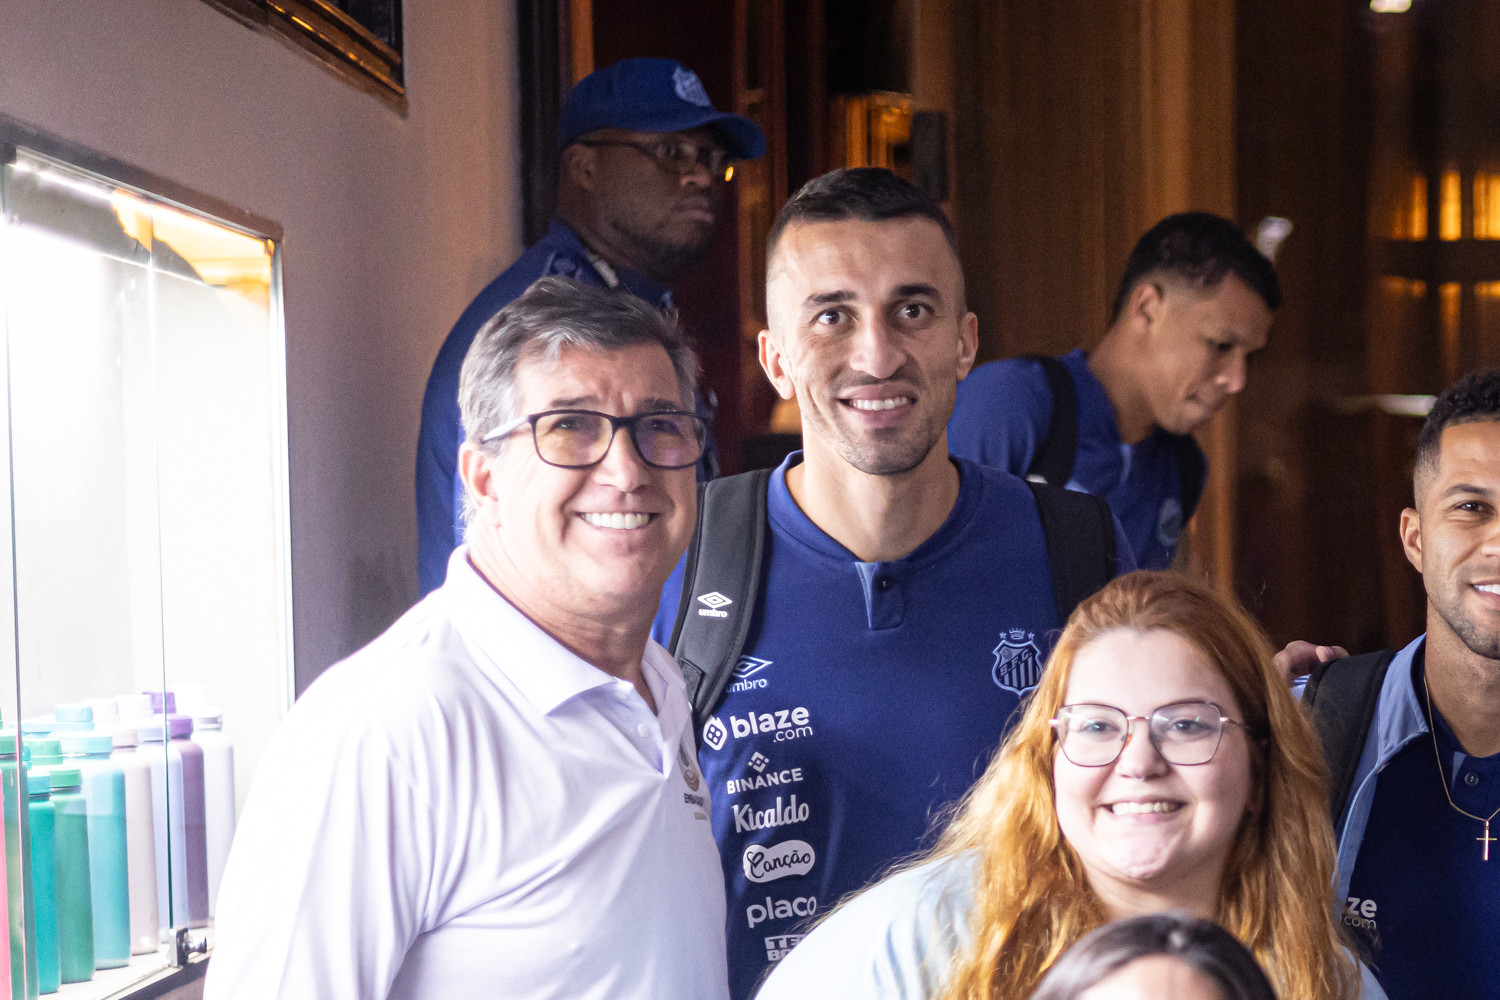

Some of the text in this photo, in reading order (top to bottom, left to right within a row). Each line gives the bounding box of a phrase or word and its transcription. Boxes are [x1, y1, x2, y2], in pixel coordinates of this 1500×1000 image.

[698, 608, 728, 618] umbro
[728, 678, 768, 694] mbro
[729, 706, 810, 739] blaze
[773, 726, 814, 743] .com
[726, 768, 804, 795] BINANCE
[731, 794, 809, 833] Kicaldo
[746, 849, 811, 878] Canção
[746, 896, 817, 928] placo
[768, 937, 799, 949] TE
